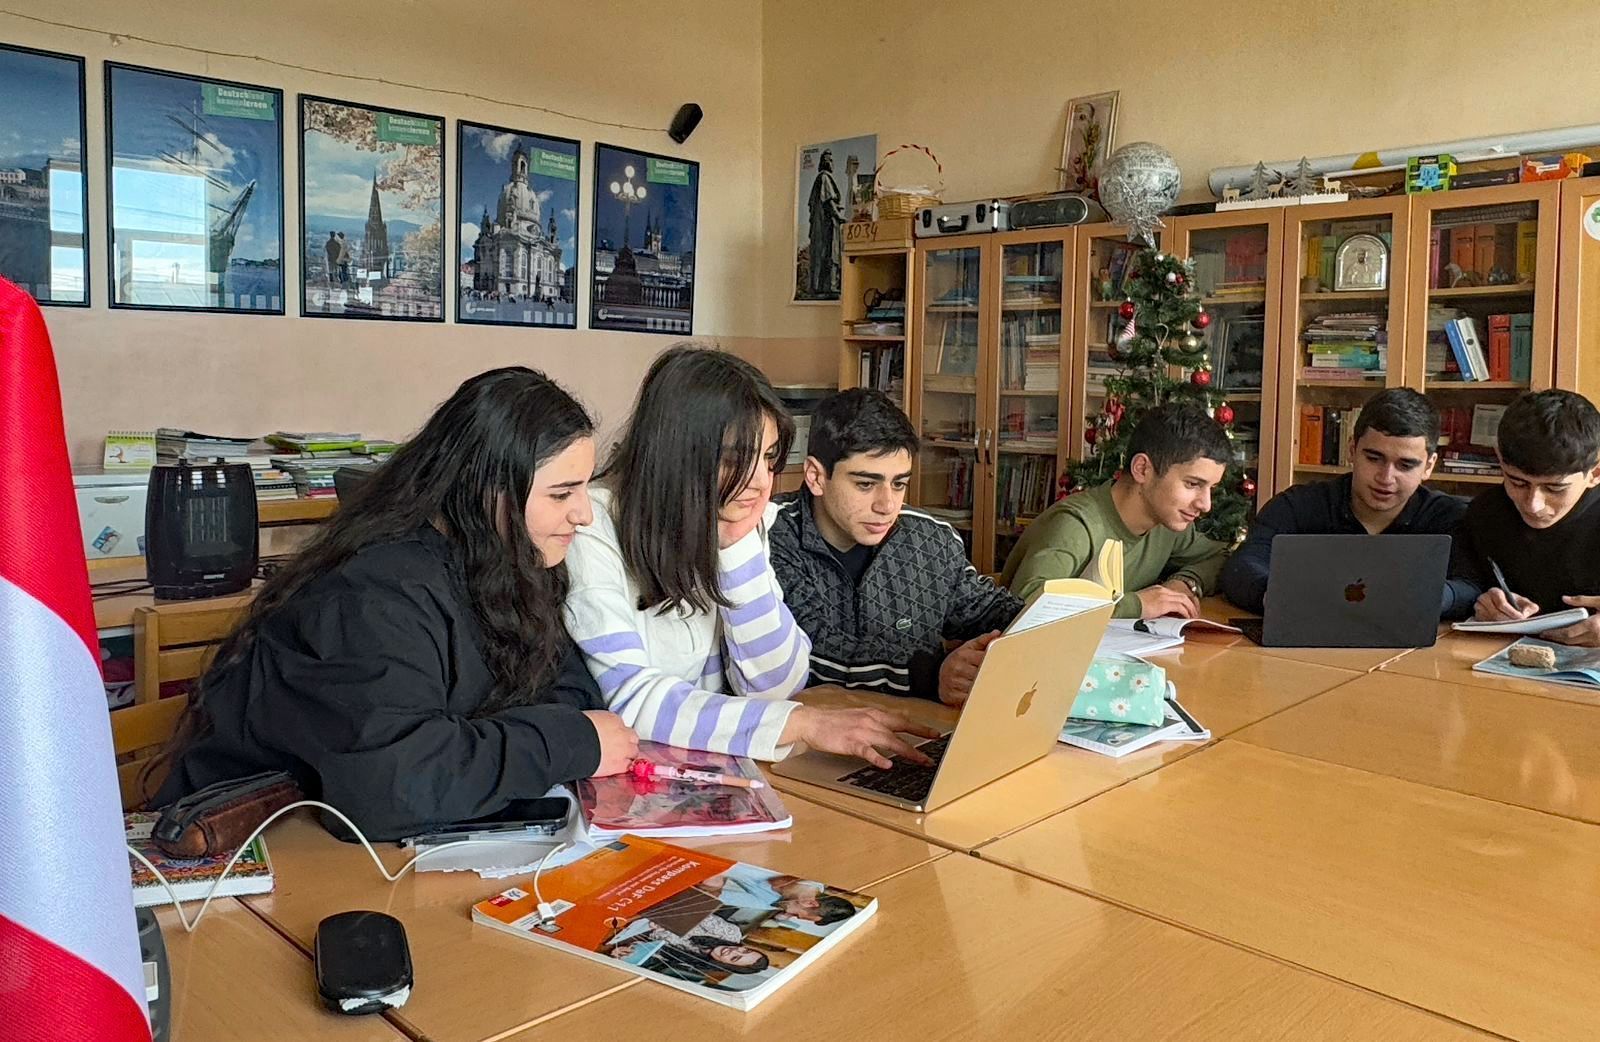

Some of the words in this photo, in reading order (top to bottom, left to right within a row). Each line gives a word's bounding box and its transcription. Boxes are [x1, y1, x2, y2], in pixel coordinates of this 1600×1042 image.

[846, 222, 878, 241] 8034
[650, 860, 701, 885] Kompass
[631, 884, 656, 899] DaF
